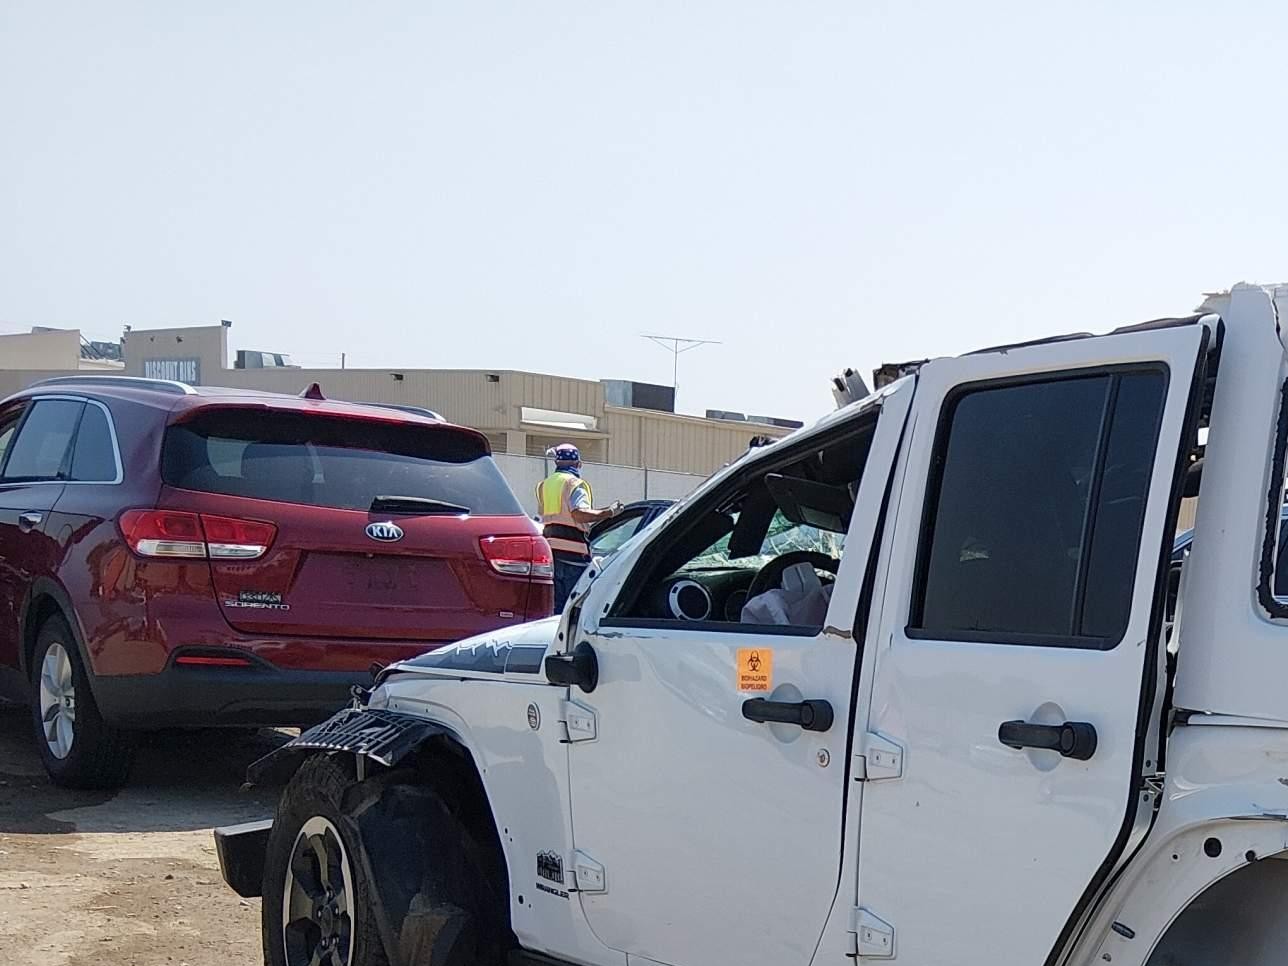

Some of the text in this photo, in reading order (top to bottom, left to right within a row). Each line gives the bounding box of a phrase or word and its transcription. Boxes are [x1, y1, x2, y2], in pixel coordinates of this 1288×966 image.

[145, 361, 178, 379] DISCOUNT
[372, 525, 398, 537] KIA
[224, 600, 290, 611] SORENTO
[535, 882, 570, 900] WRANGLER
